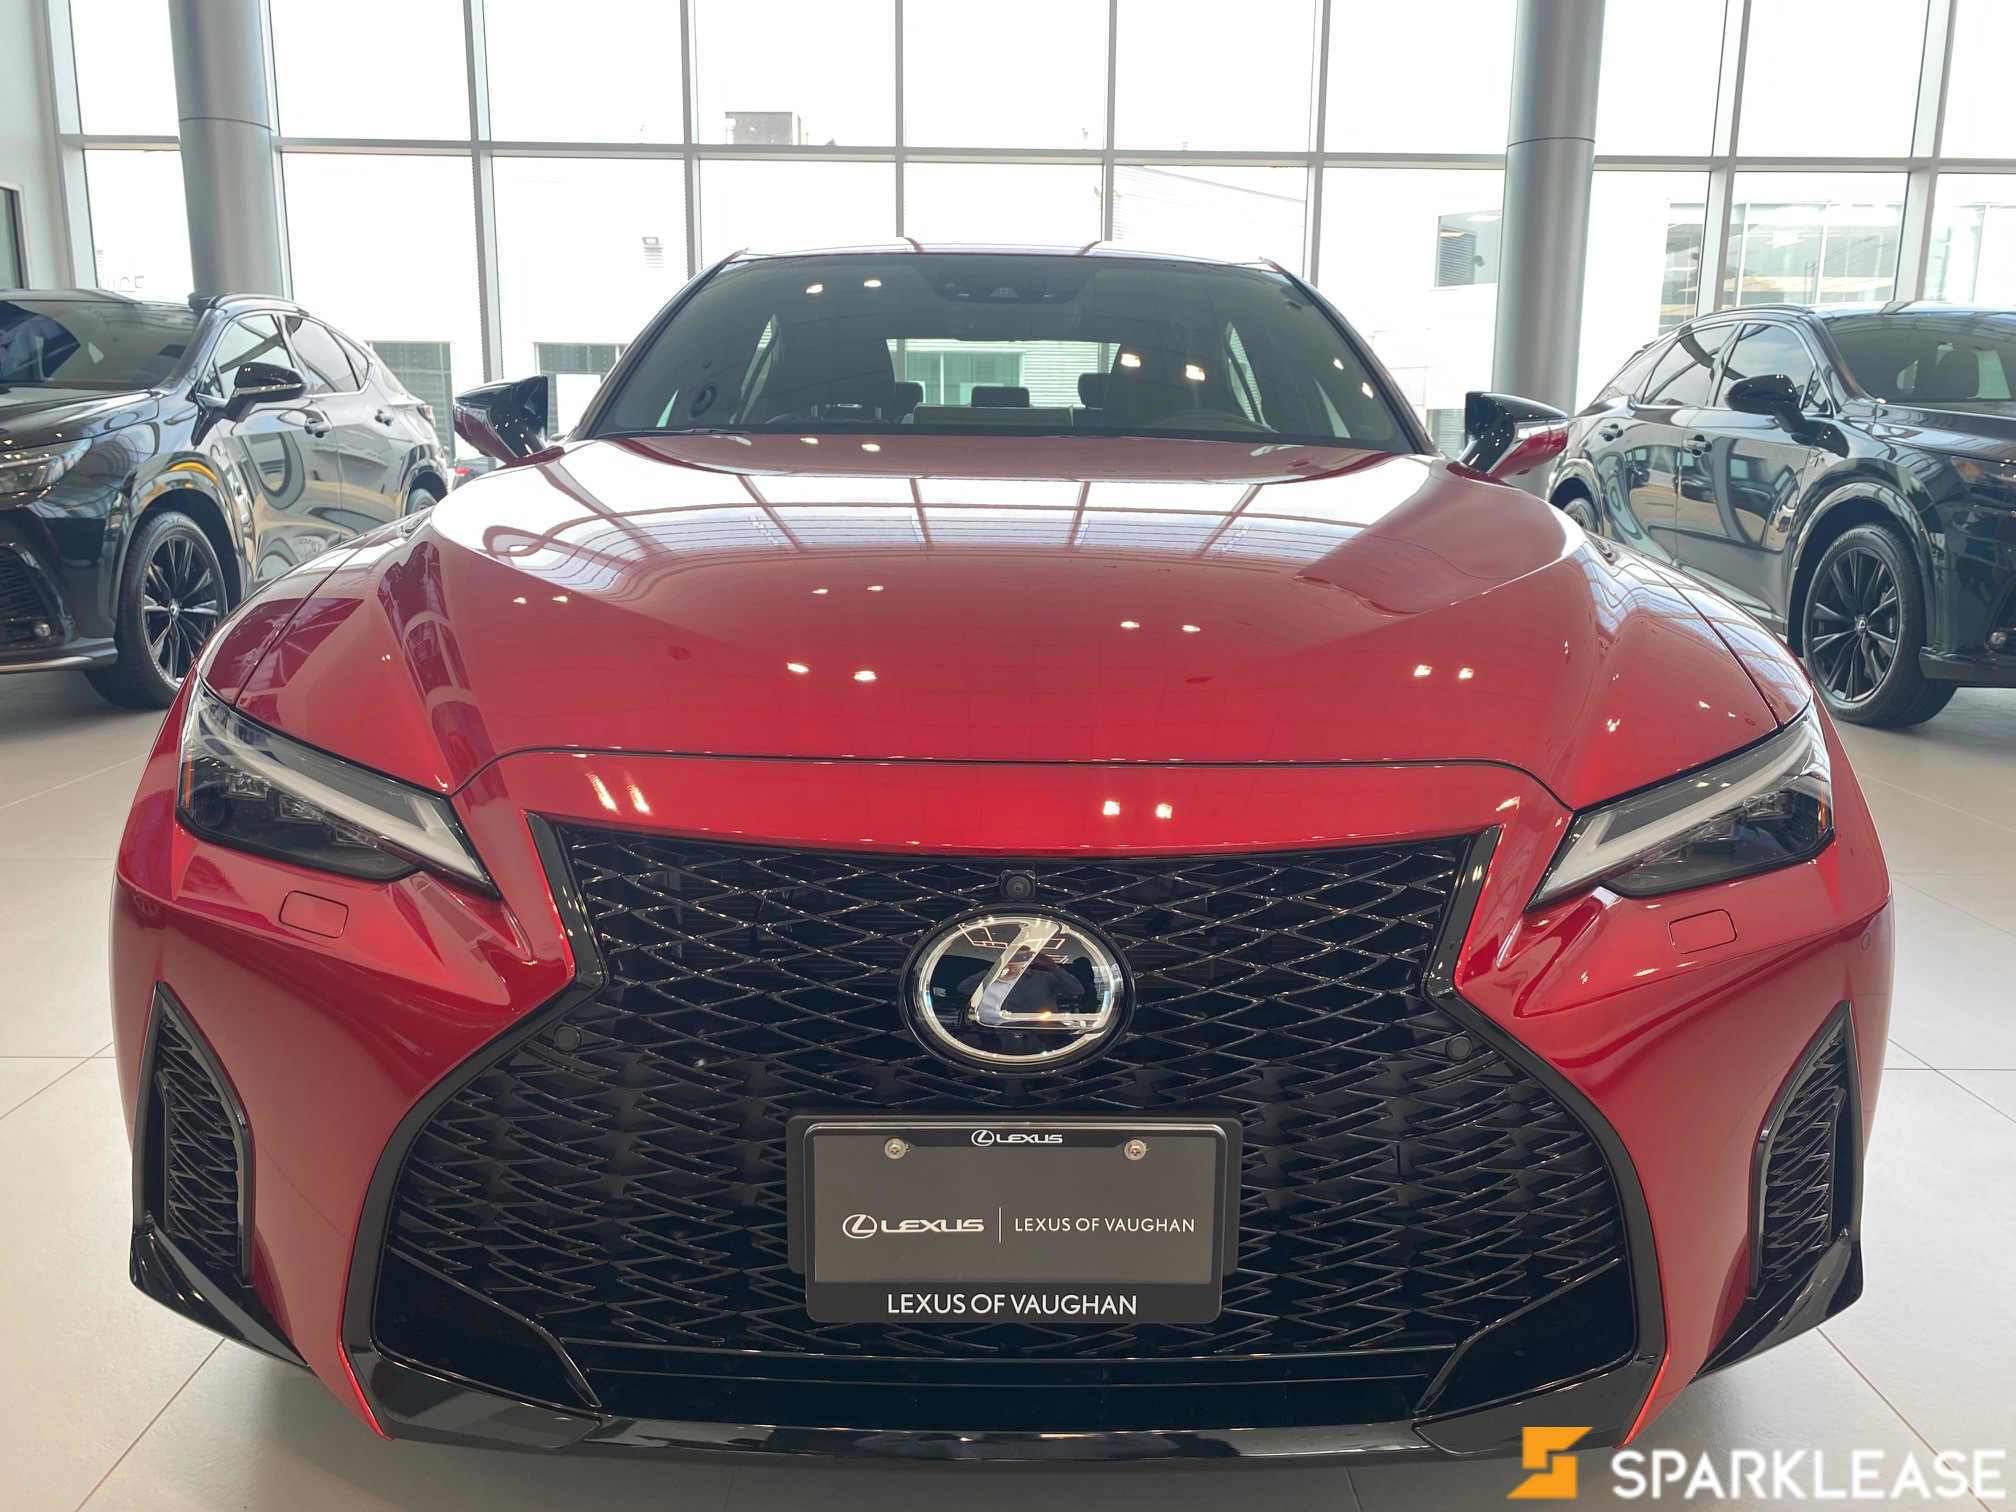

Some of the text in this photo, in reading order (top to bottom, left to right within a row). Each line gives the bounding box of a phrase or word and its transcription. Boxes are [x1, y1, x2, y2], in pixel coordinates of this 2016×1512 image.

[995, 1133, 1064, 1145] LEXUS
[880, 1218, 985, 1233] LEXUS
[1015, 1217, 1195, 1233] LEXUS OF VAUGHAN
[888, 1293, 1138, 1315] LEXUS OF VAUGHAN
